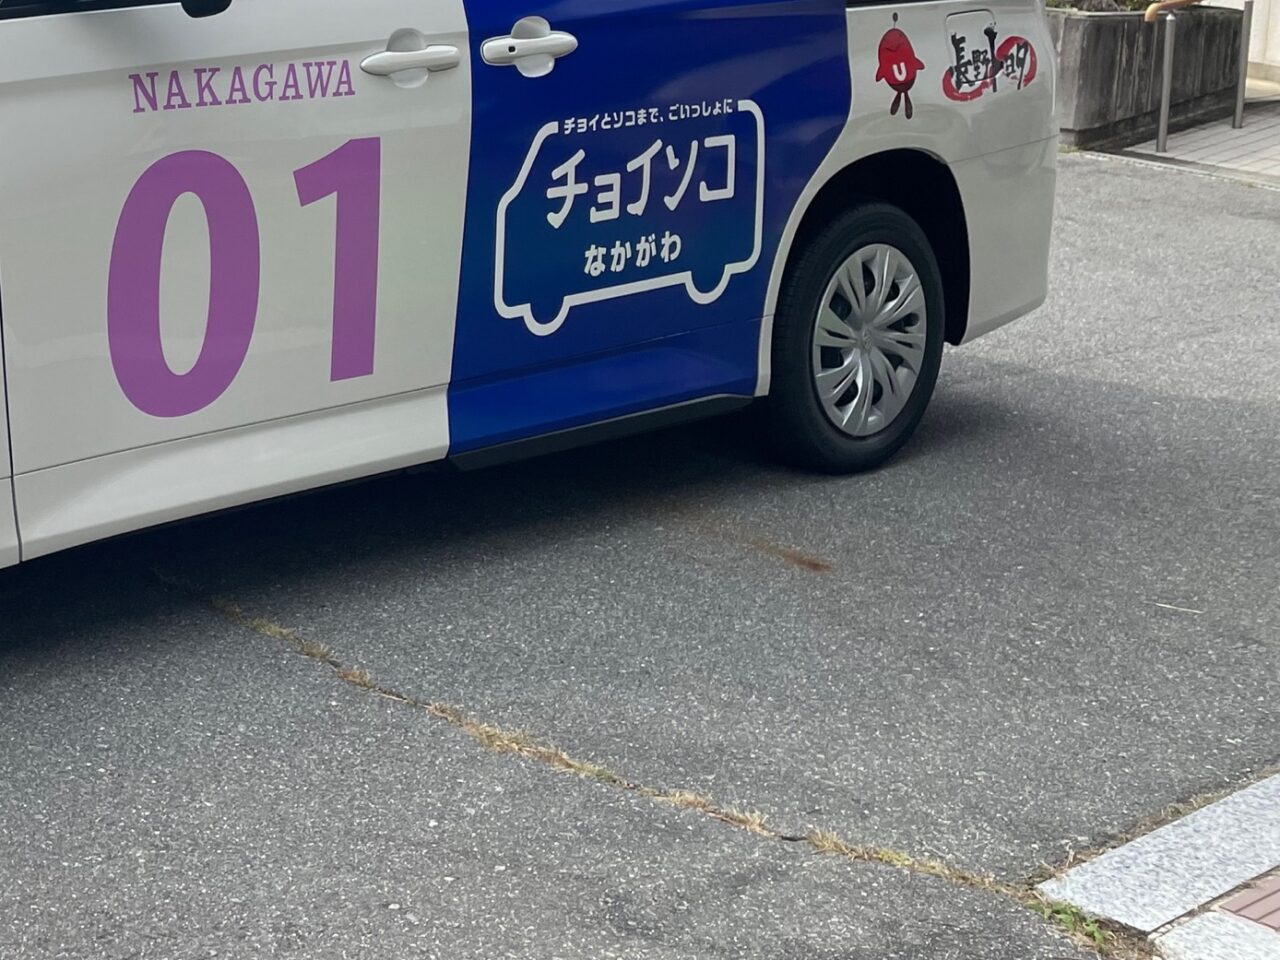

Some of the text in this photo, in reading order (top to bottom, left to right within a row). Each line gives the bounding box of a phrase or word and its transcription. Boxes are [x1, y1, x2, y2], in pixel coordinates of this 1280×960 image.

[128, 59, 356, 114] NAKAGAWA
[546, 134, 736, 230] チョイソコ
[106, 136, 381, 418] 01
[583, 230, 682, 277] なかがわ
